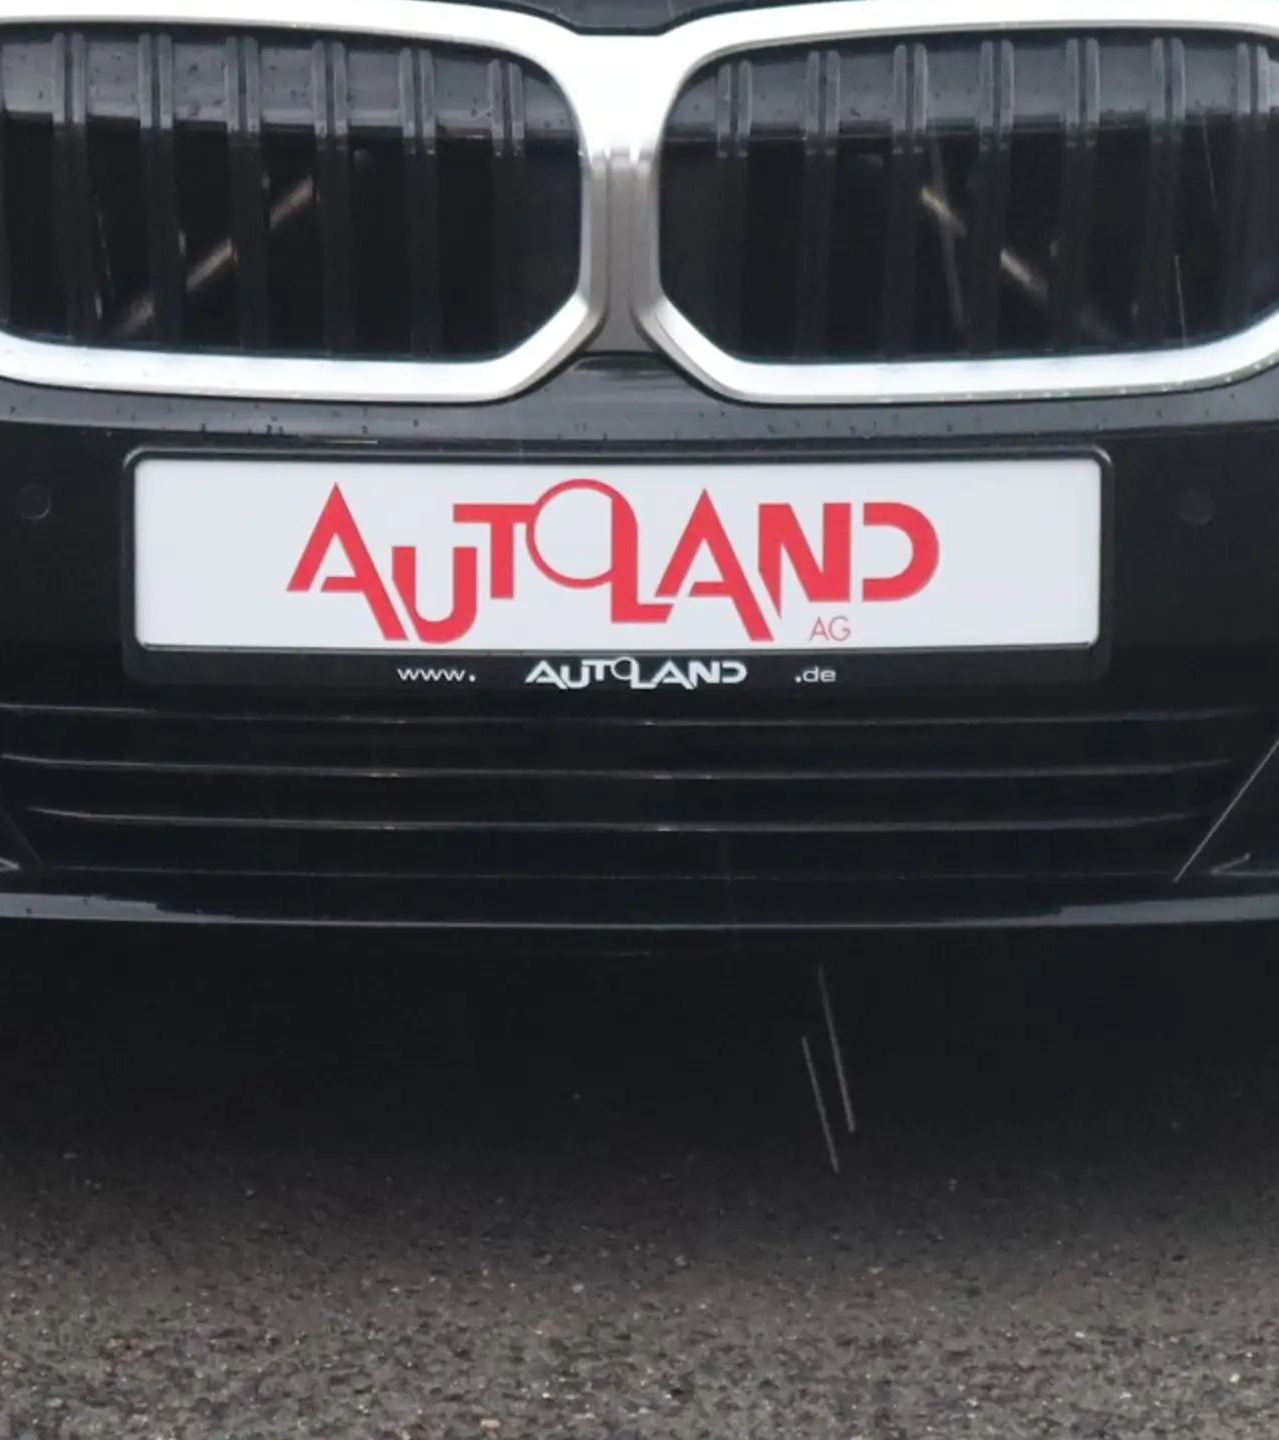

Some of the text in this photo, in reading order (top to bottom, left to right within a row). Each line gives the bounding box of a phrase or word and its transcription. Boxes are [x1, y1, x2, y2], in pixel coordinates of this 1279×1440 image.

[287, 477, 941, 645] AUTOLAND
[809, 616, 852, 643] AG
[397, 656, 837, 690] www. AUTOLAND .de
